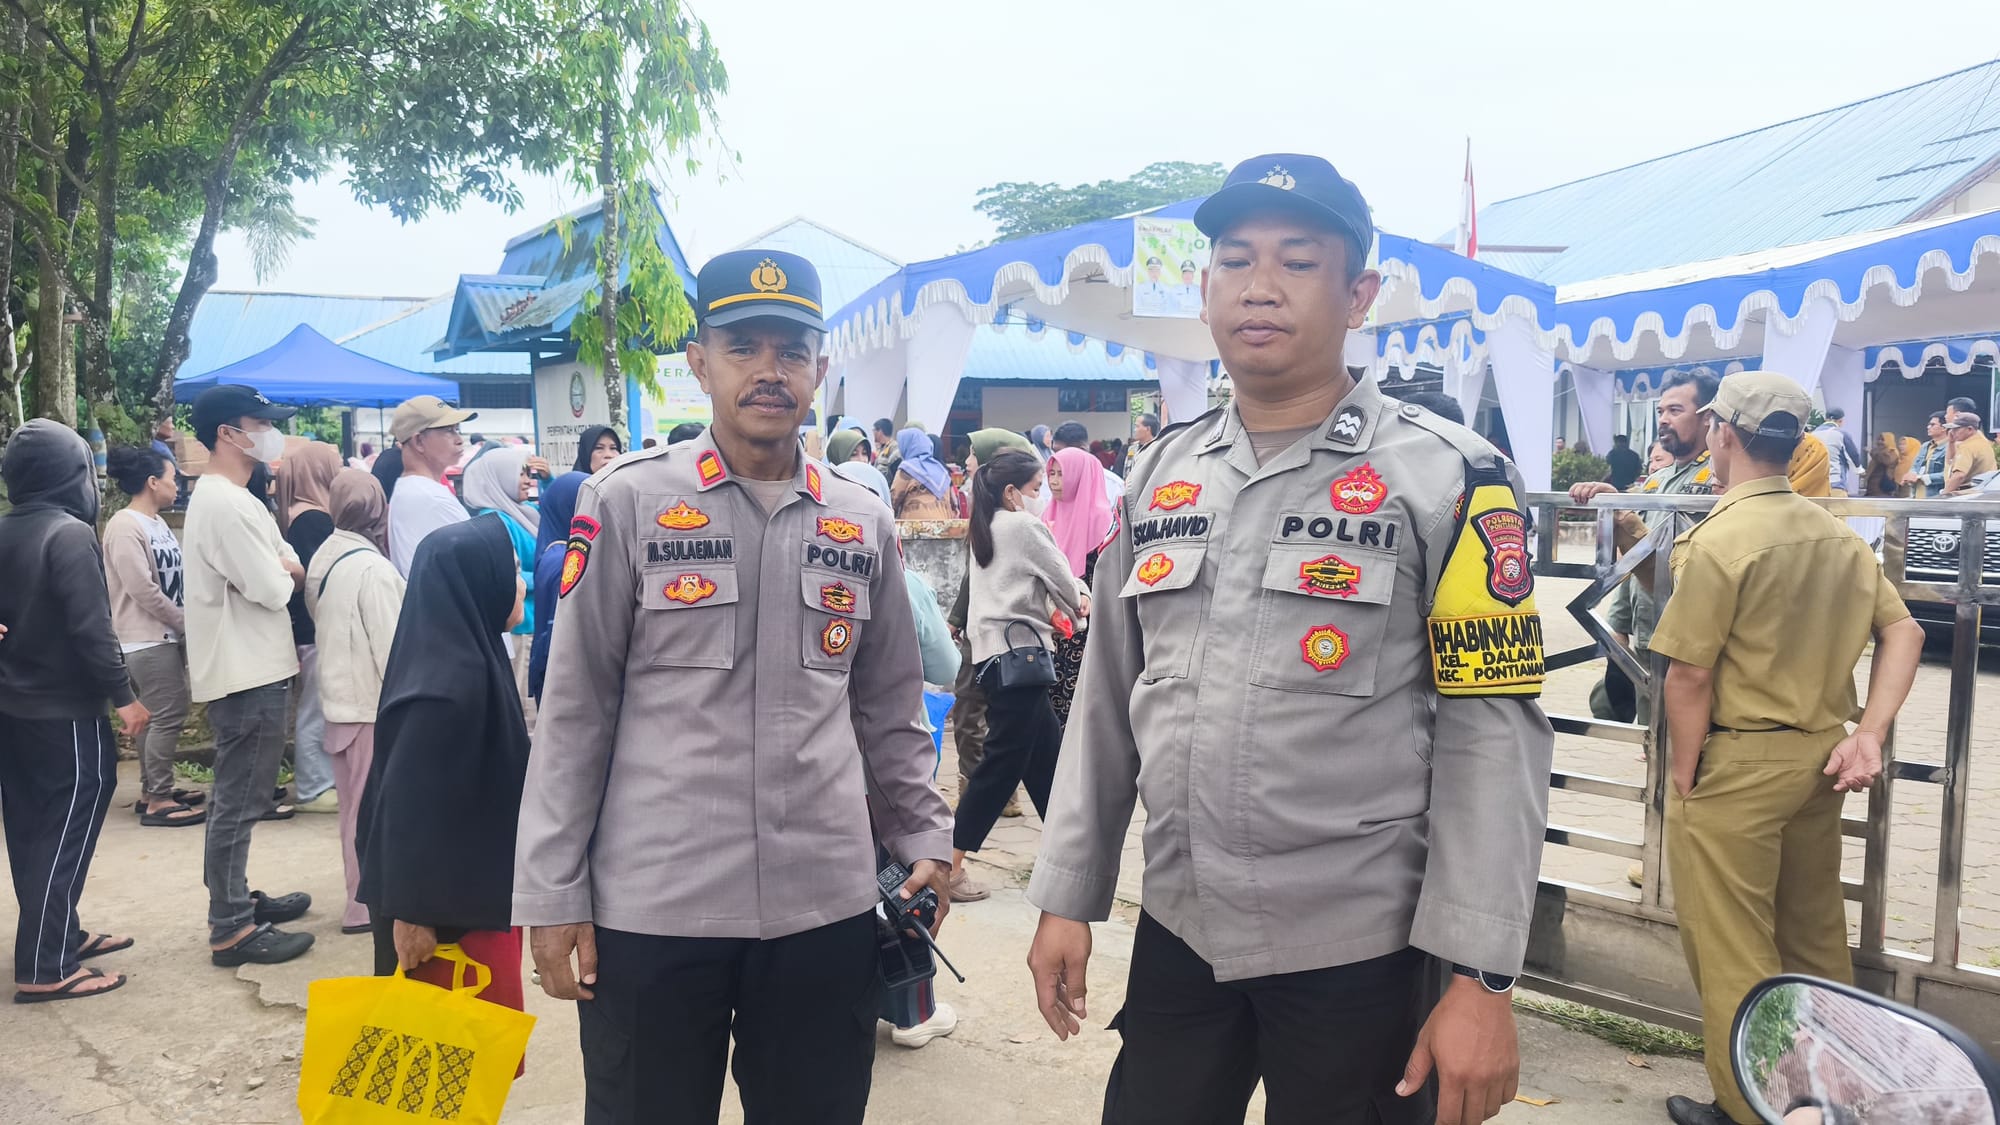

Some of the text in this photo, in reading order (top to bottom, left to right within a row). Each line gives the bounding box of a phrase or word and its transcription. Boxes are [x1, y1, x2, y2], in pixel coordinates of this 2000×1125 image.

[1282, 516, 1395, 548] POLRI
[647, 540, 732, 562] M.SULAEMAN
[808, 544, 873, 576] POLRI
[1440, 654, 1469, 668] KEL.
[1482, 648, 1536, 665] DALAM
[1438, 669, 1464, 682] KEC.
